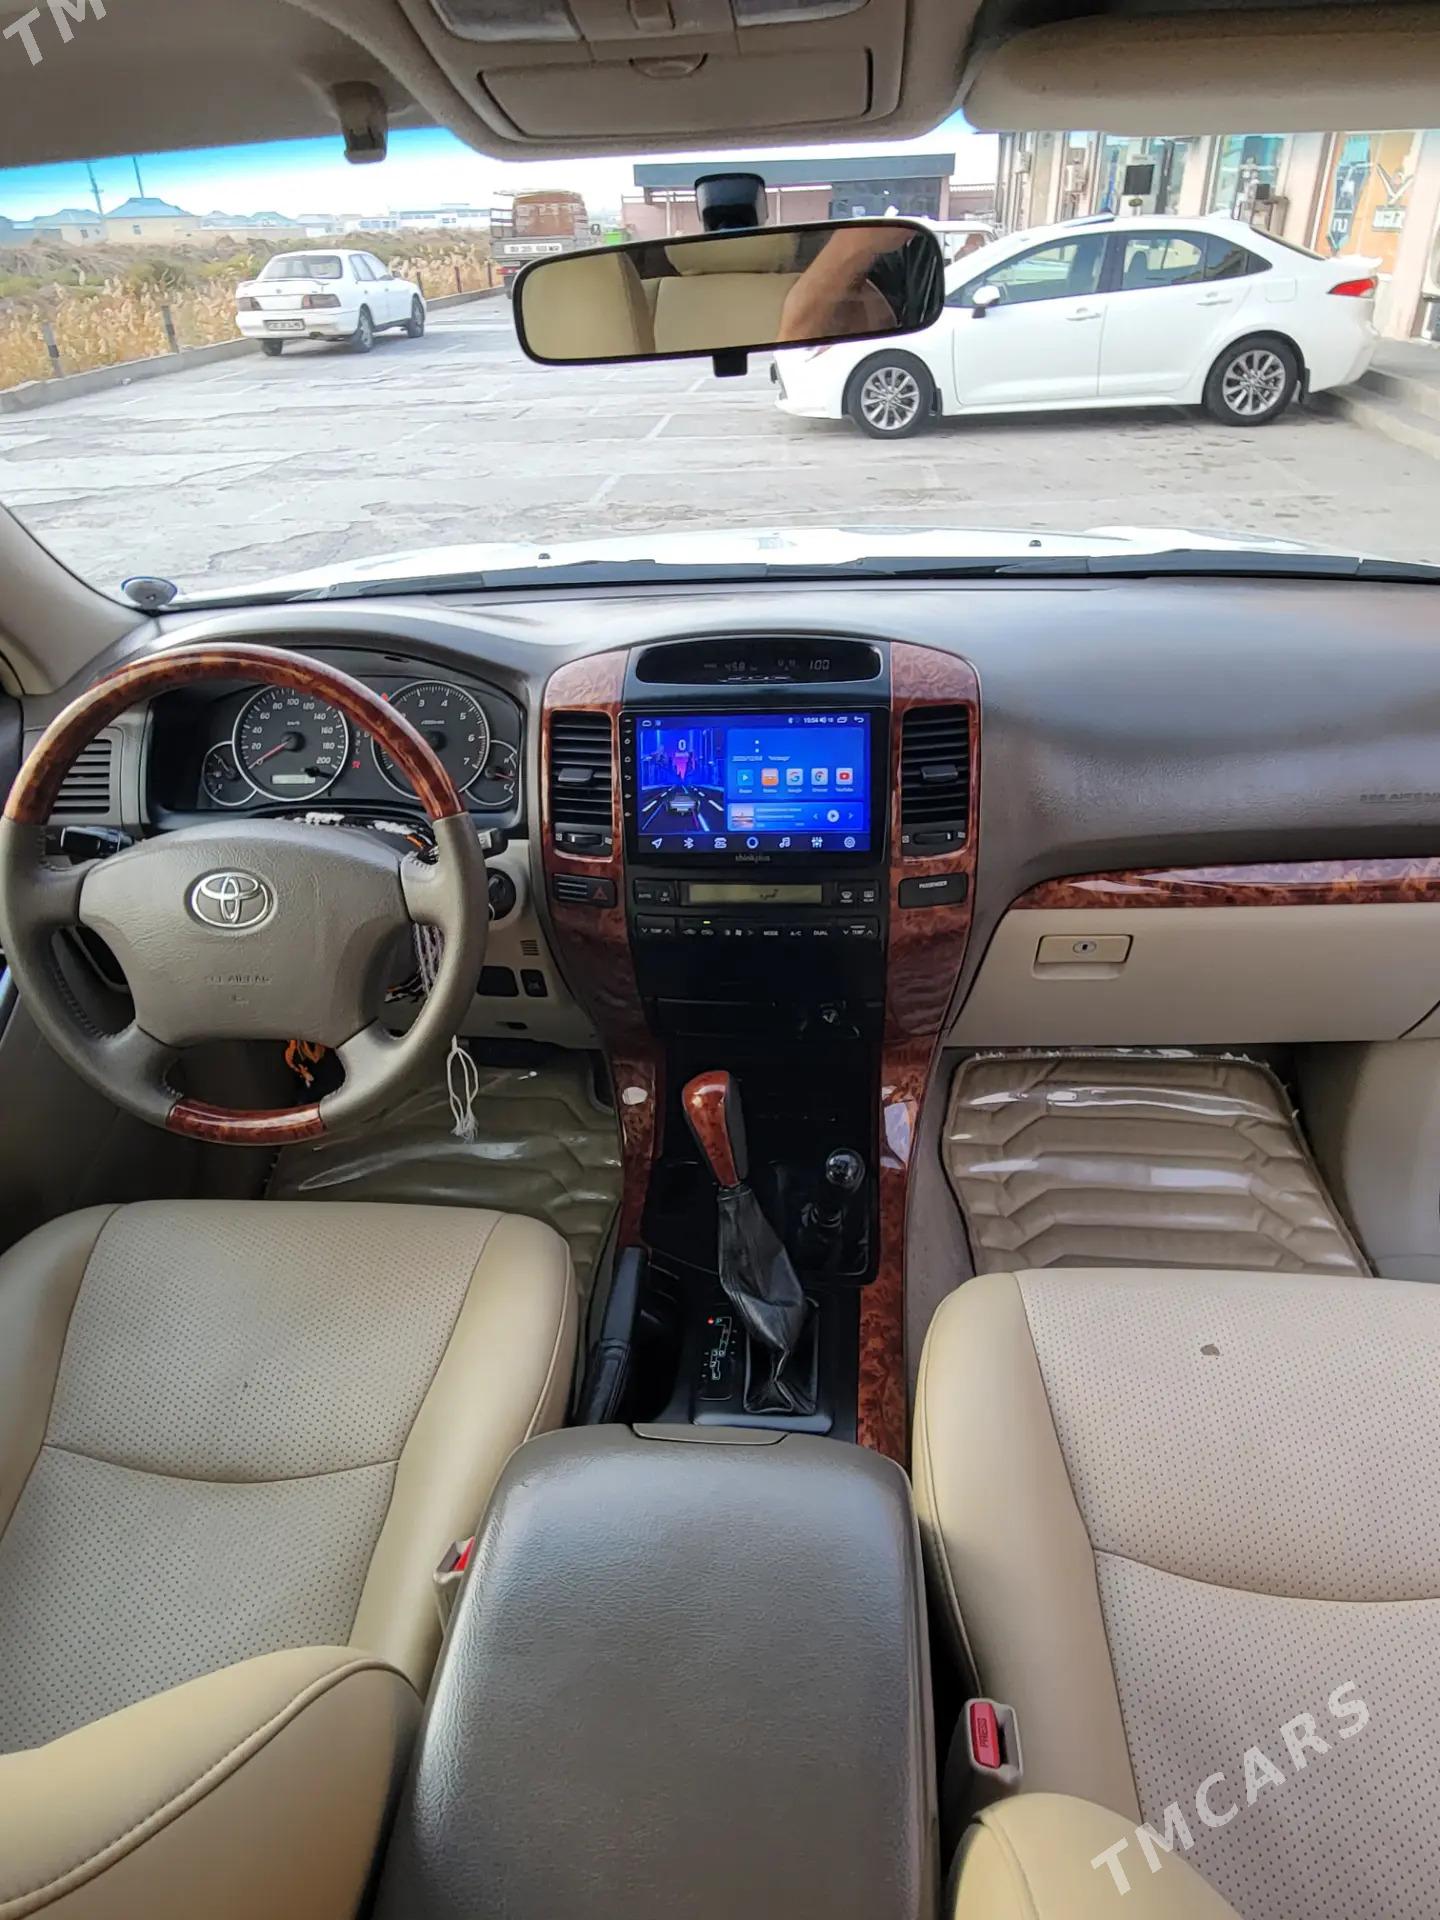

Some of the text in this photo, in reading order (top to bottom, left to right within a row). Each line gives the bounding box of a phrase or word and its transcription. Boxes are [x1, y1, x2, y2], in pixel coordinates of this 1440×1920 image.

[272, 702, 283, 710] 80
[286, 698, 301, 706] 100
[303, 702, 315, 710] 120
[418, 699, 425, 707] 3
[441, 699, 448, 707] 4
[260, 711, 271, 720] 60
[313, 712, 327, 720] 140
[460, 712, 467, 720] 5
[252, 726, 263, 734] 40
[321, 726, 334, 734] 160
[468, 733, 475, 742] 6
[251, 742, 262, 750] 20
[322, 742, 335, 750] 180
[678, 739, 686, 751] 0
[316, 756, 331, 764] 200
[463, 758, 470, 766] 7
[977, 1717, 989, 1748] PRESS
